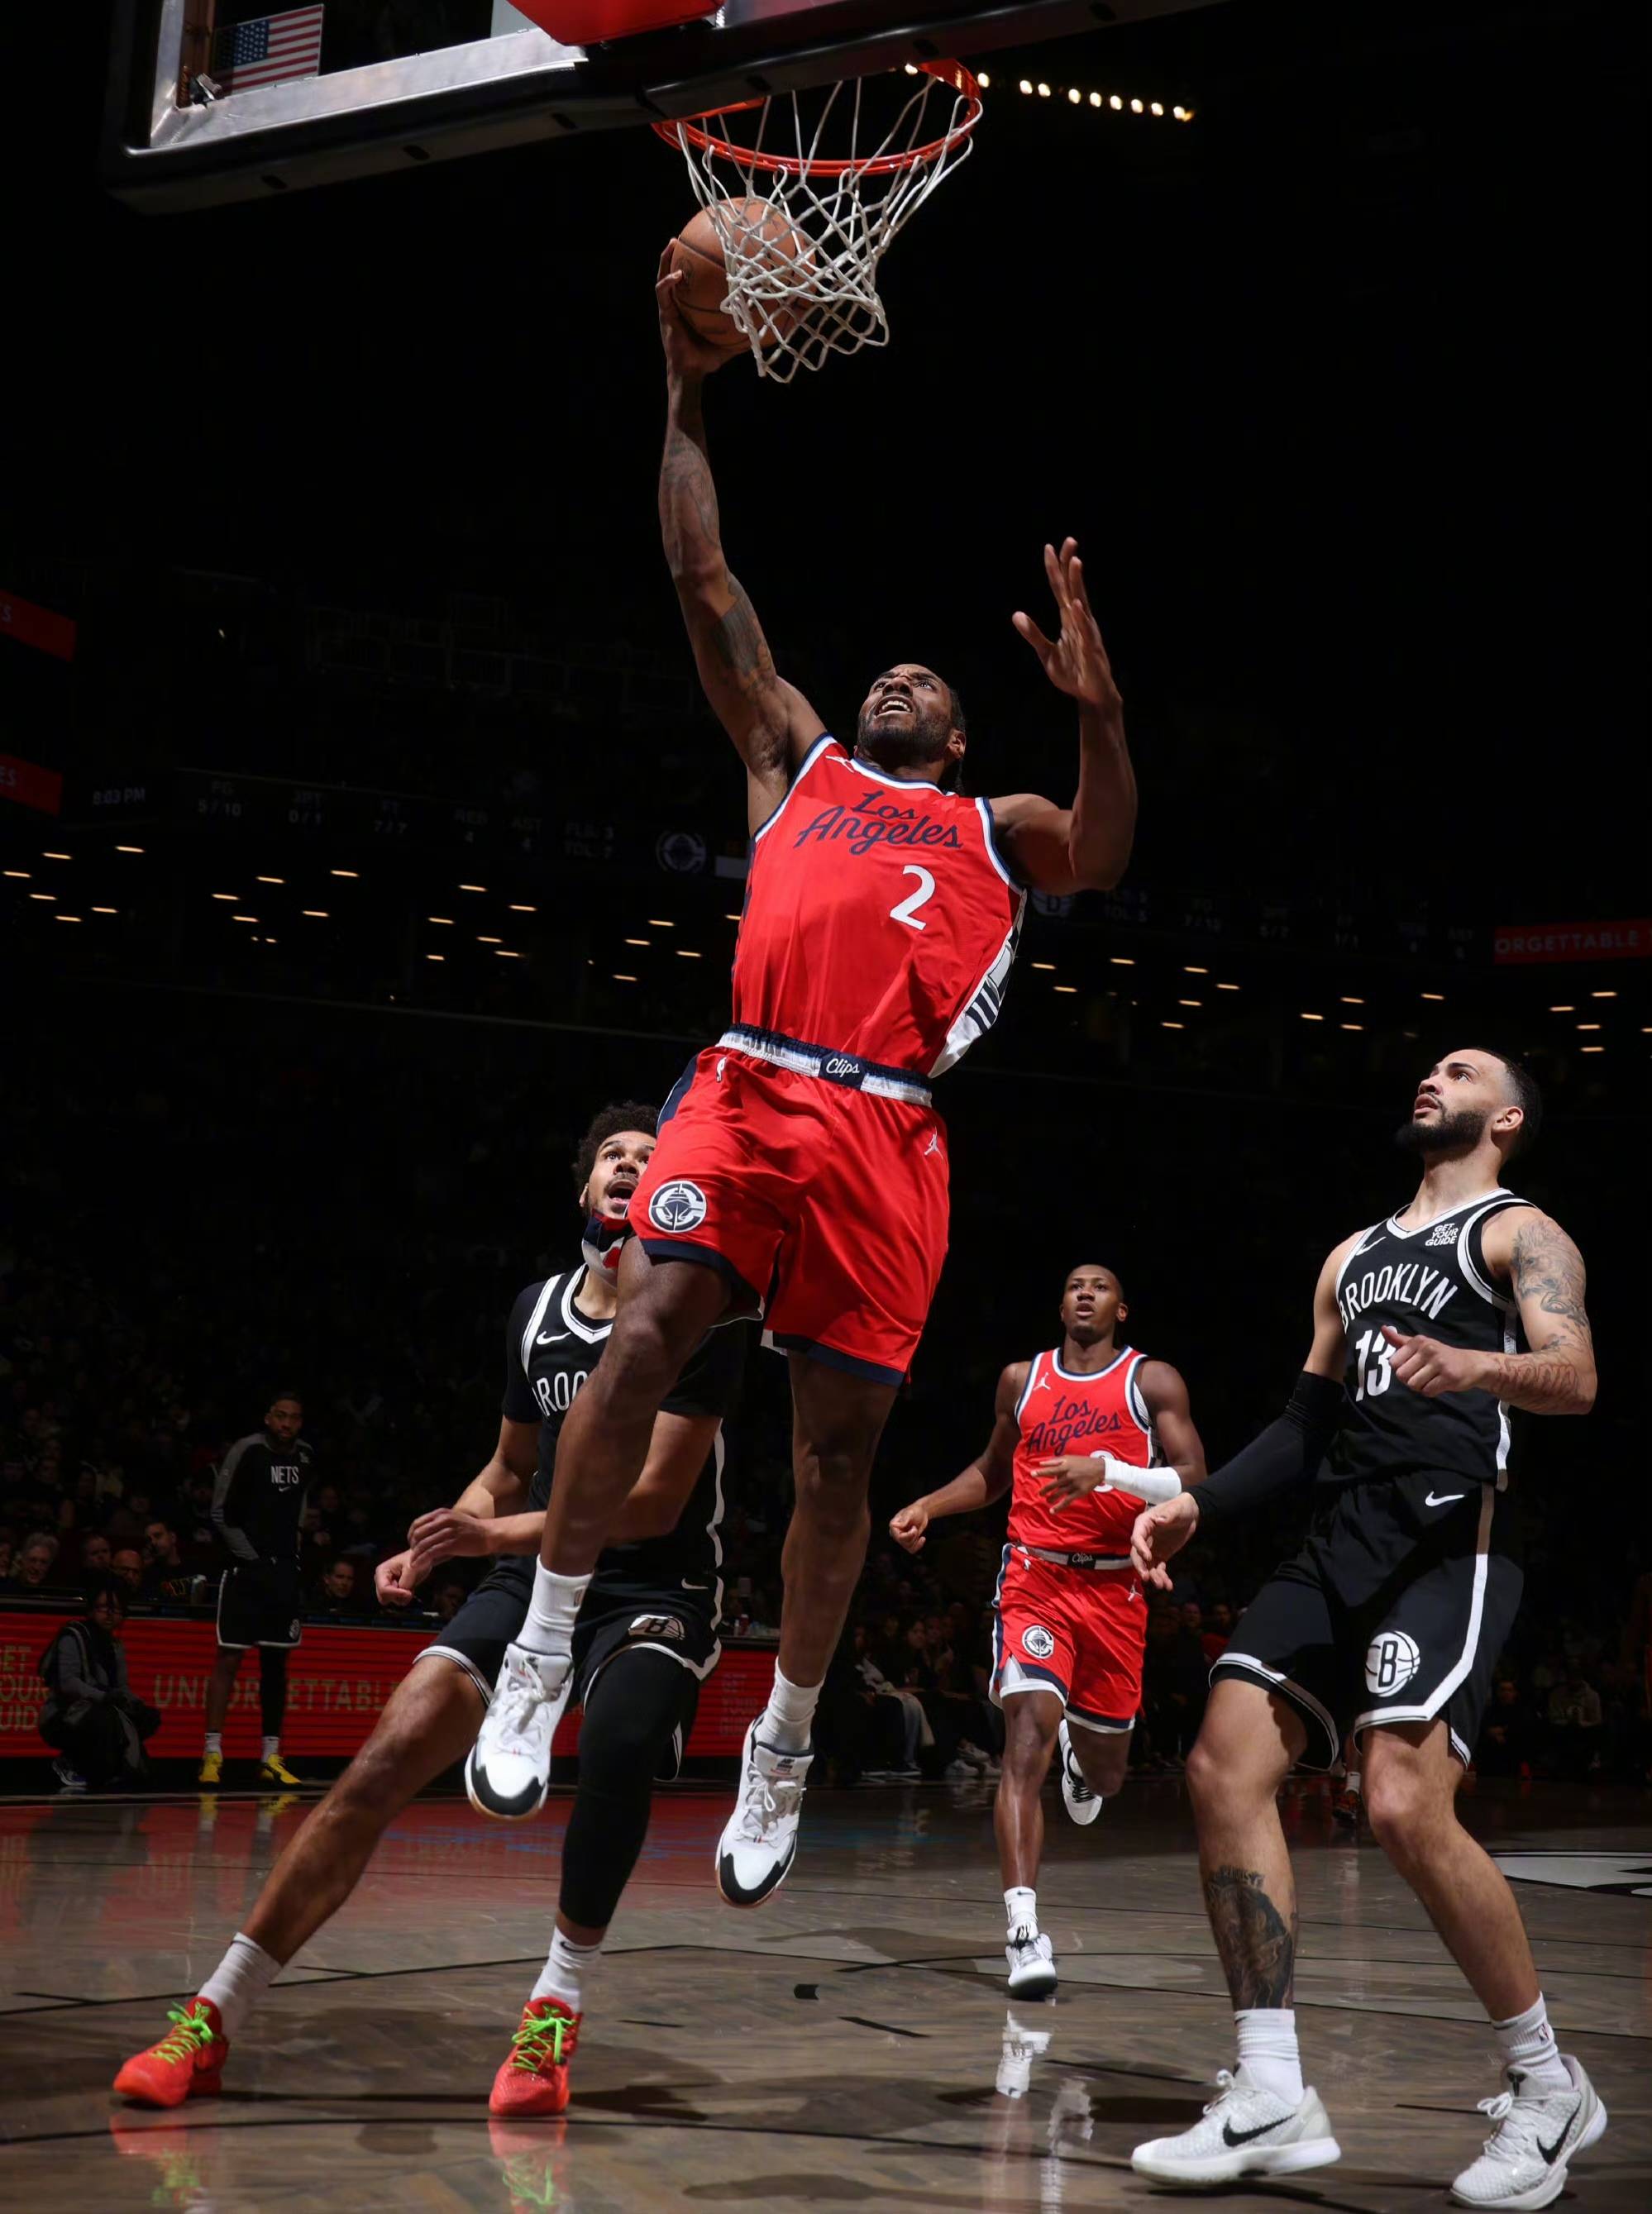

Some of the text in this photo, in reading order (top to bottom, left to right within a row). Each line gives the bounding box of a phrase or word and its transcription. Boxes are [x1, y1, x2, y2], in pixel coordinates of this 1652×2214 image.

[851, 790, 918, 820] Los
[793, 805, 964, 855] Angeles
[890, 865, 936, 931] 2
[826, 1057, 861, 1077] Clips
[1425, 1236, 1458, 1247] GUIDE
[1431, 1228, 1459, 1239] YOUR
[1434, 1223, 1455, 1233] GET
[1339, 1263, 1459, 1336] BROOKLYN
[1355, 1325, 1397, 1402] 13
[1049, 1396, 1091, 1424] Los
[1027, 1408, 1121, 1456] Angeles
[270, 1465, 299, 1484] NETS
[1071, 1553, 1095, 1565] Clips
